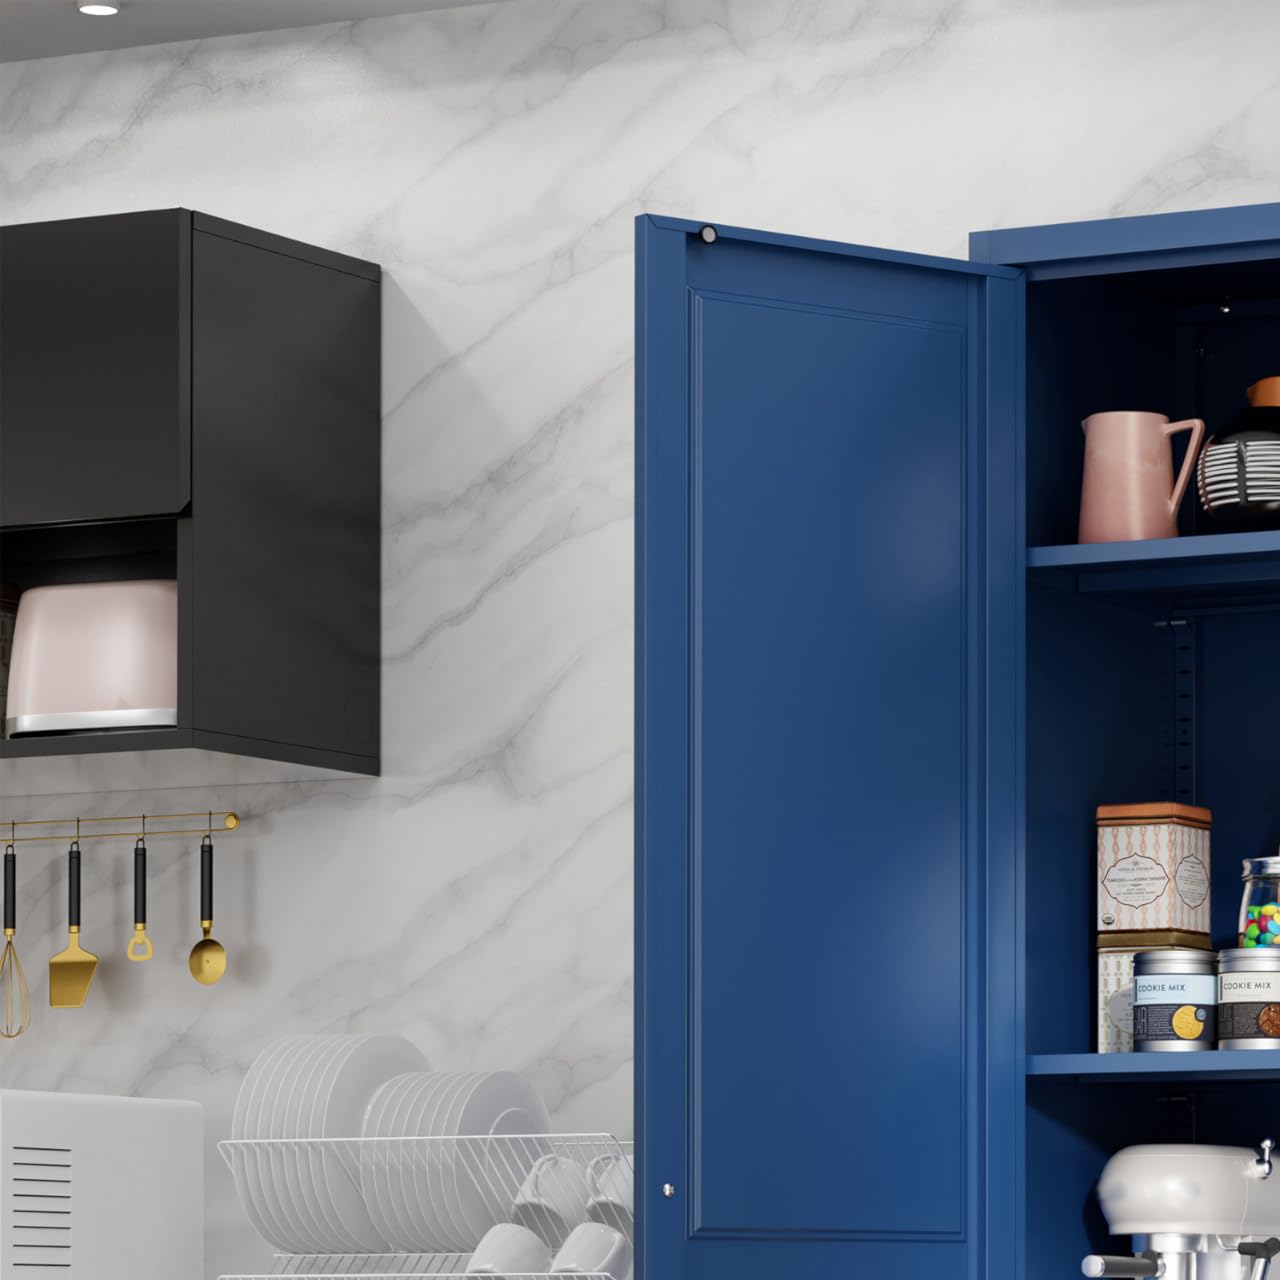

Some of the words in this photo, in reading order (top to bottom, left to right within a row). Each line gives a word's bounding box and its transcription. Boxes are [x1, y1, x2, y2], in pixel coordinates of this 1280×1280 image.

[1138, 984, 1166, 992] COOKIE
[1169, 984, 1185, 992] MIX
[1223, 982, 1252, 990] COOKIE
[1255, 982, 1272, 990] MIX
